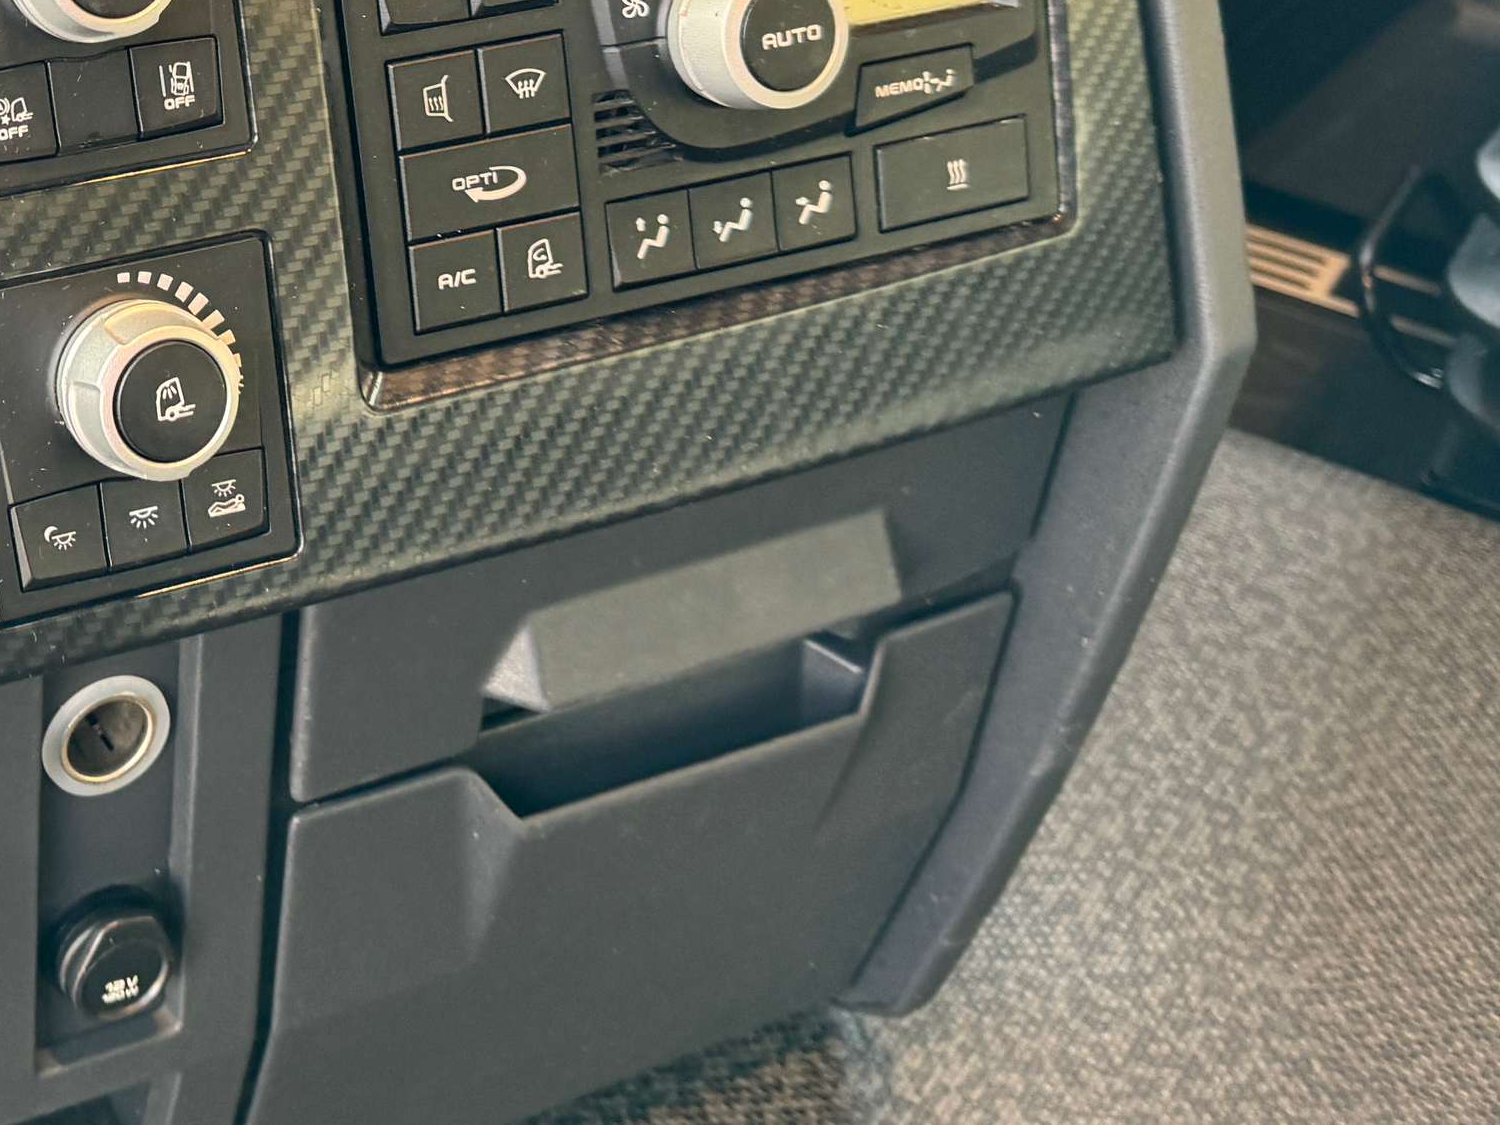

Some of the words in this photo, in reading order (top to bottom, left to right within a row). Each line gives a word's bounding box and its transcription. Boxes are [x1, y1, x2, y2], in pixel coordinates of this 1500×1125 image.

[762, 24, 822, 51] AUTO
[164, 94, 196, 111] OFF
[451, 170, 499, 192] OPTI
[437, 268, 477, 291] A/C
